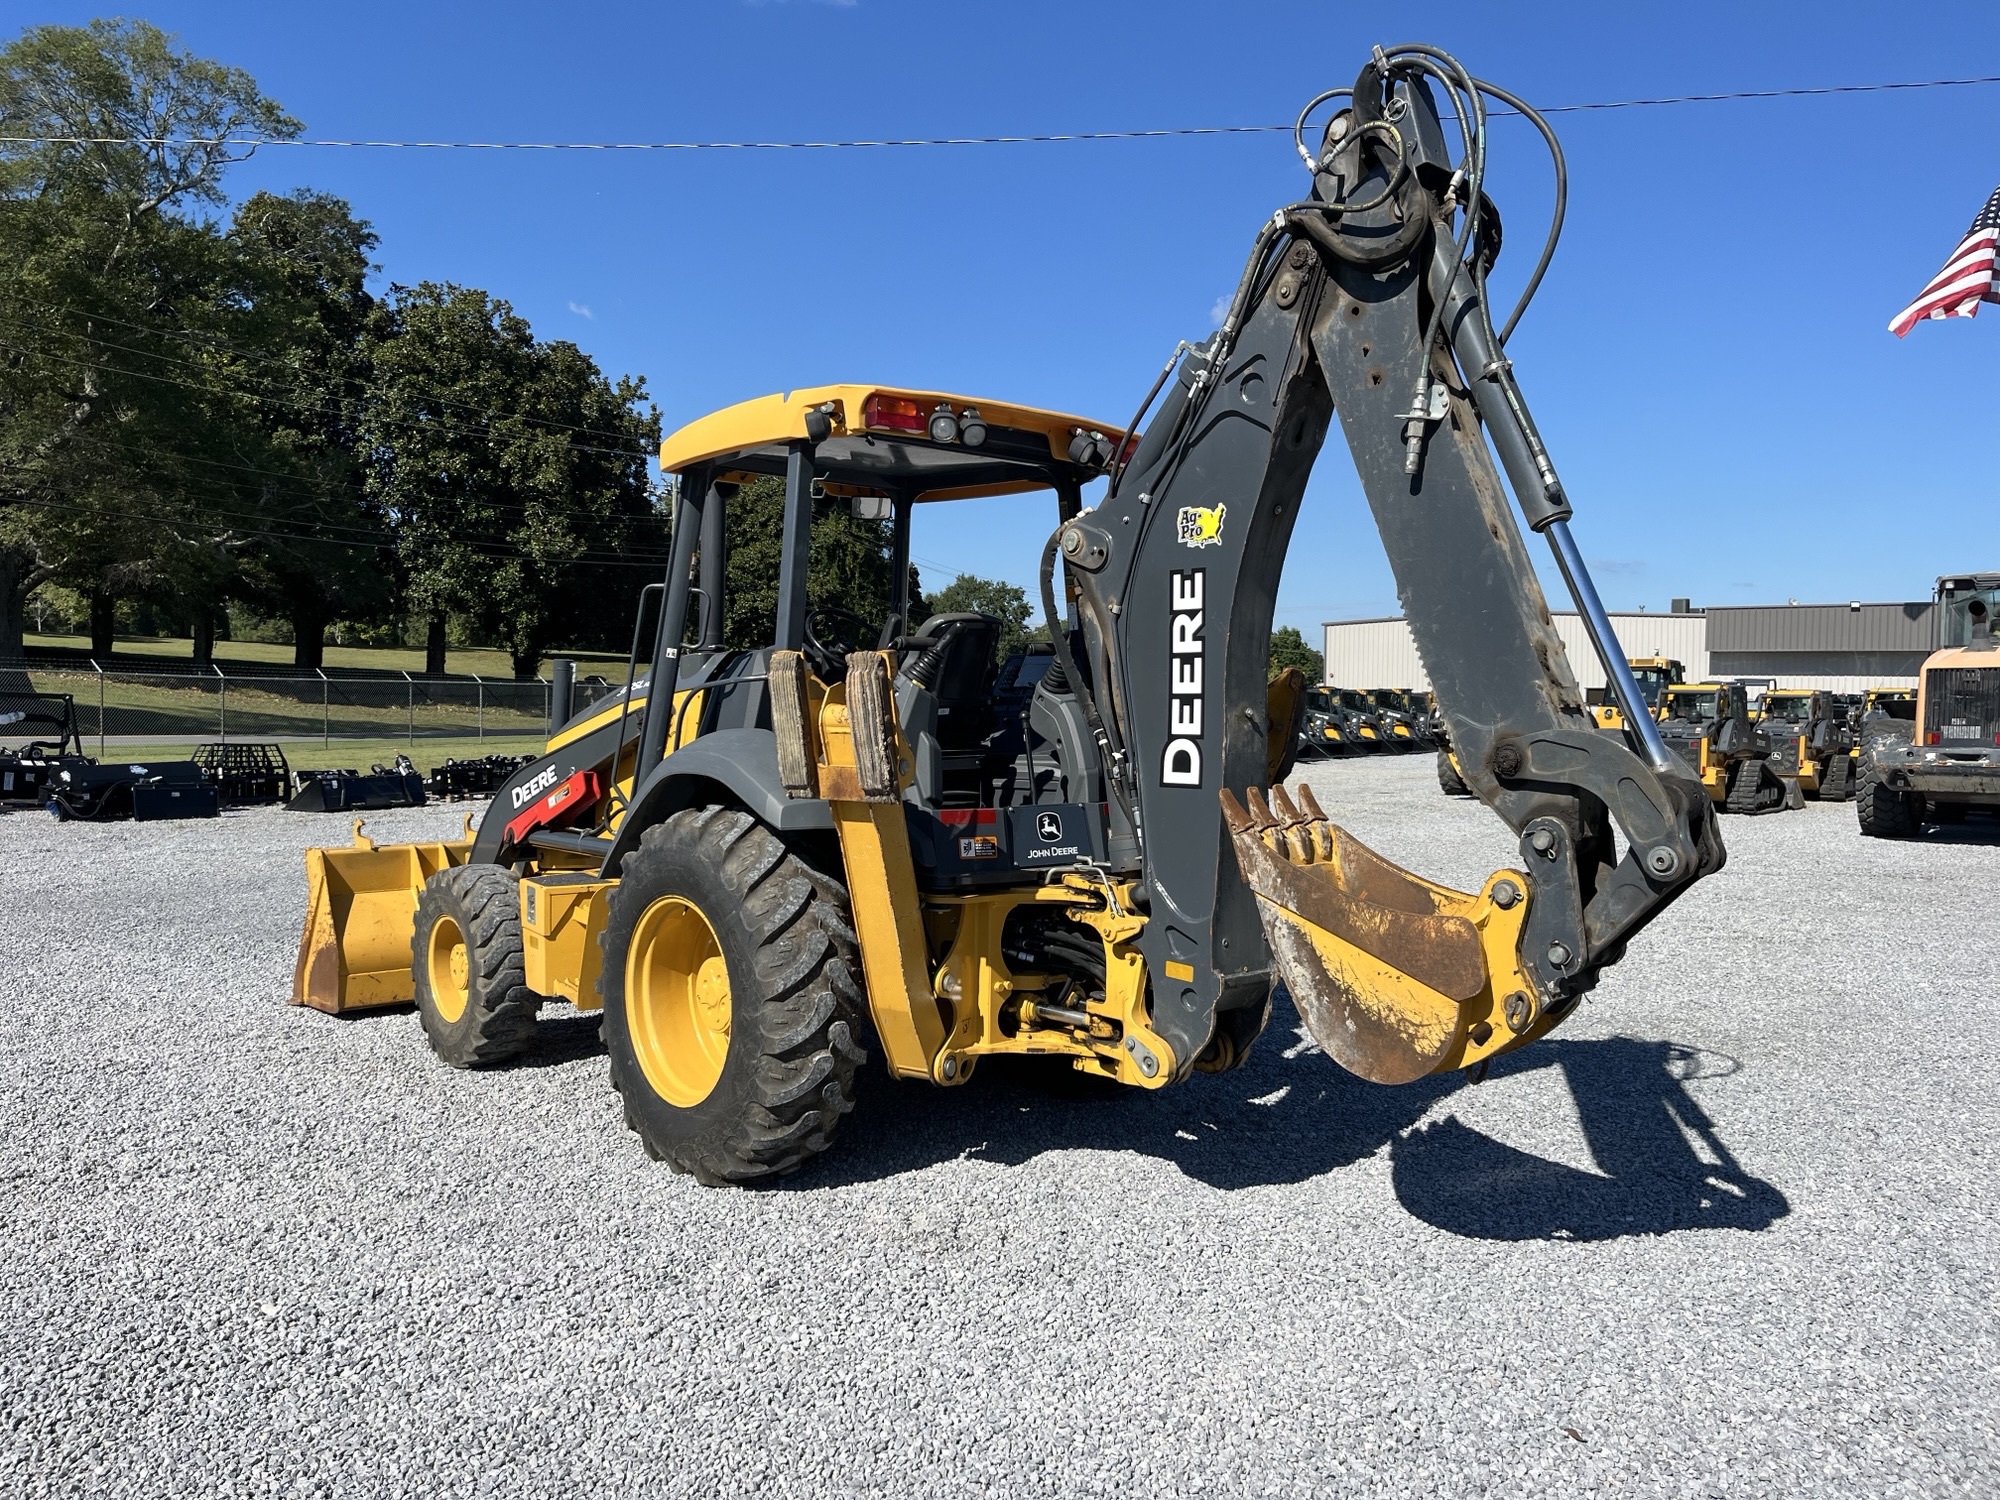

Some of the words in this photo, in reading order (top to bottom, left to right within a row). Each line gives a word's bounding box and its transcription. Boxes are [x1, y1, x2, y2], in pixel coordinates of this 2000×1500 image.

[1181, 525, 1203, 539] Pro
[1162, 571, 1204, 786] DEERE
[511, 763, 558, 810] DEERE
[1027, 849, 1051, 859] JOHN
[1051, 846, 1079, 857] DEERE
